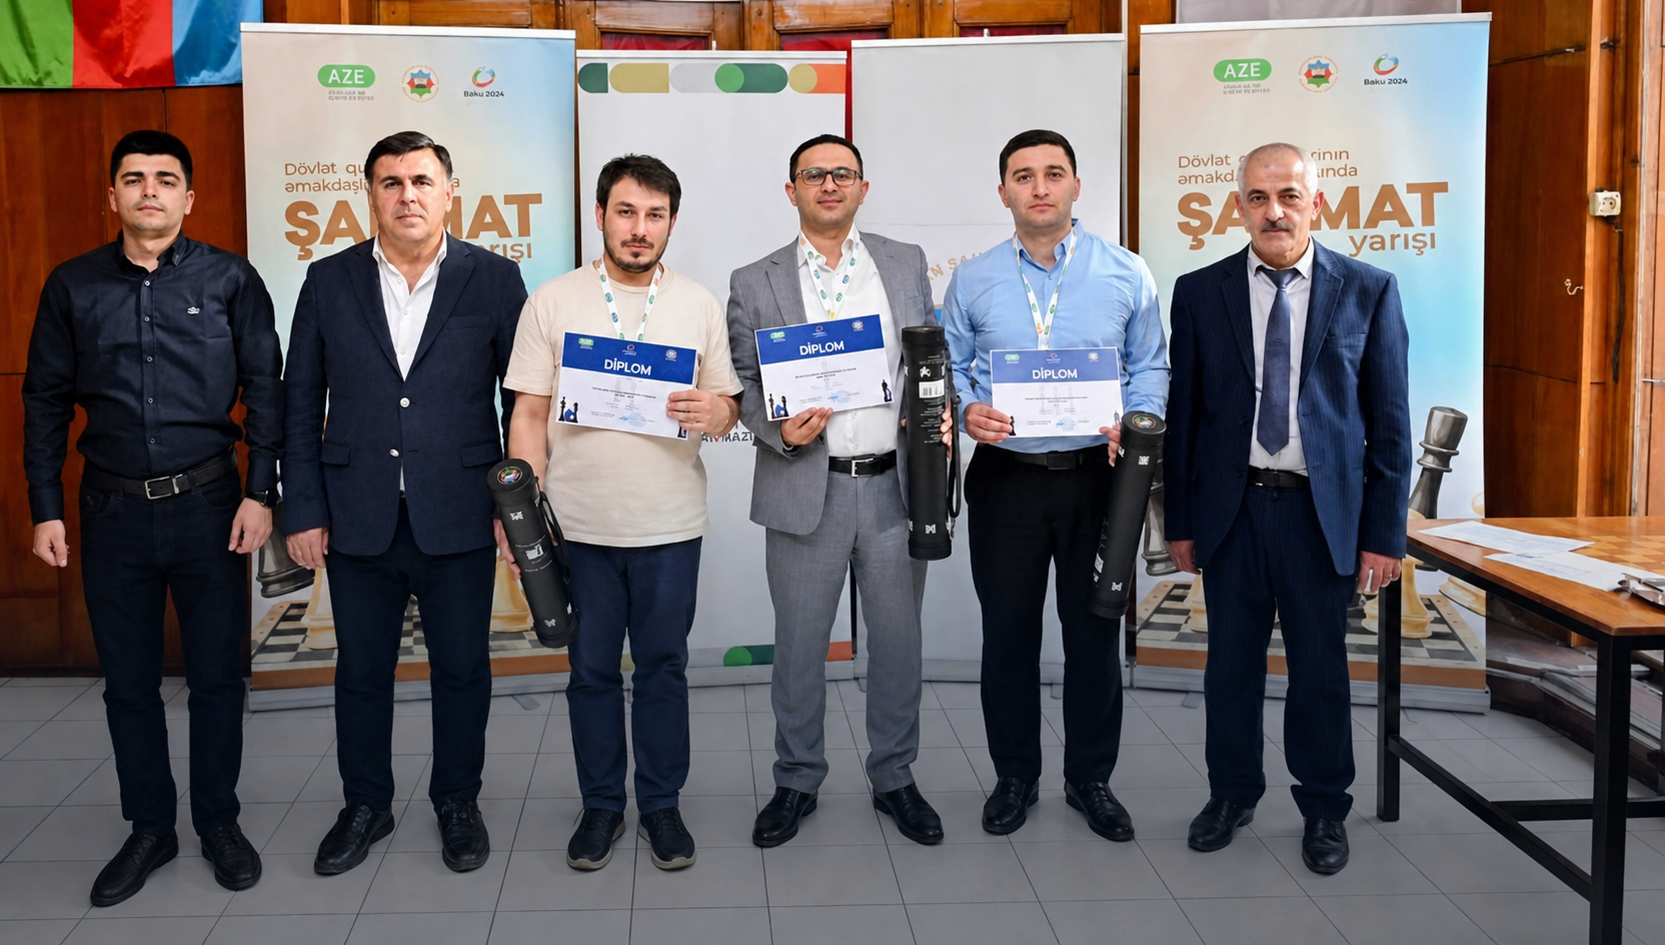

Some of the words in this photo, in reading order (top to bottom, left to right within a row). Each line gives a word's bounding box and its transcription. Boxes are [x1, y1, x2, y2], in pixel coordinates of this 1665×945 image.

[328, 69, 365, 84] AZE
[1223, 62, 1261, 79] AZE
[1363, 78, 1386, 86] Baku
[1387, 77, 1408, 85] 2024
[463, 90, 484, 98] Baku
[485, 90, 505, 98] 2024
[1177, 181, 1449, 250] ŞAMAT
[1348, 232, 1436, 258] yarışı
[799, 340, 845, 356] DİPLOM
[604, 357, 652, 376] DİPLOM
[1032, 367, 1078, 380] DİPLOM
